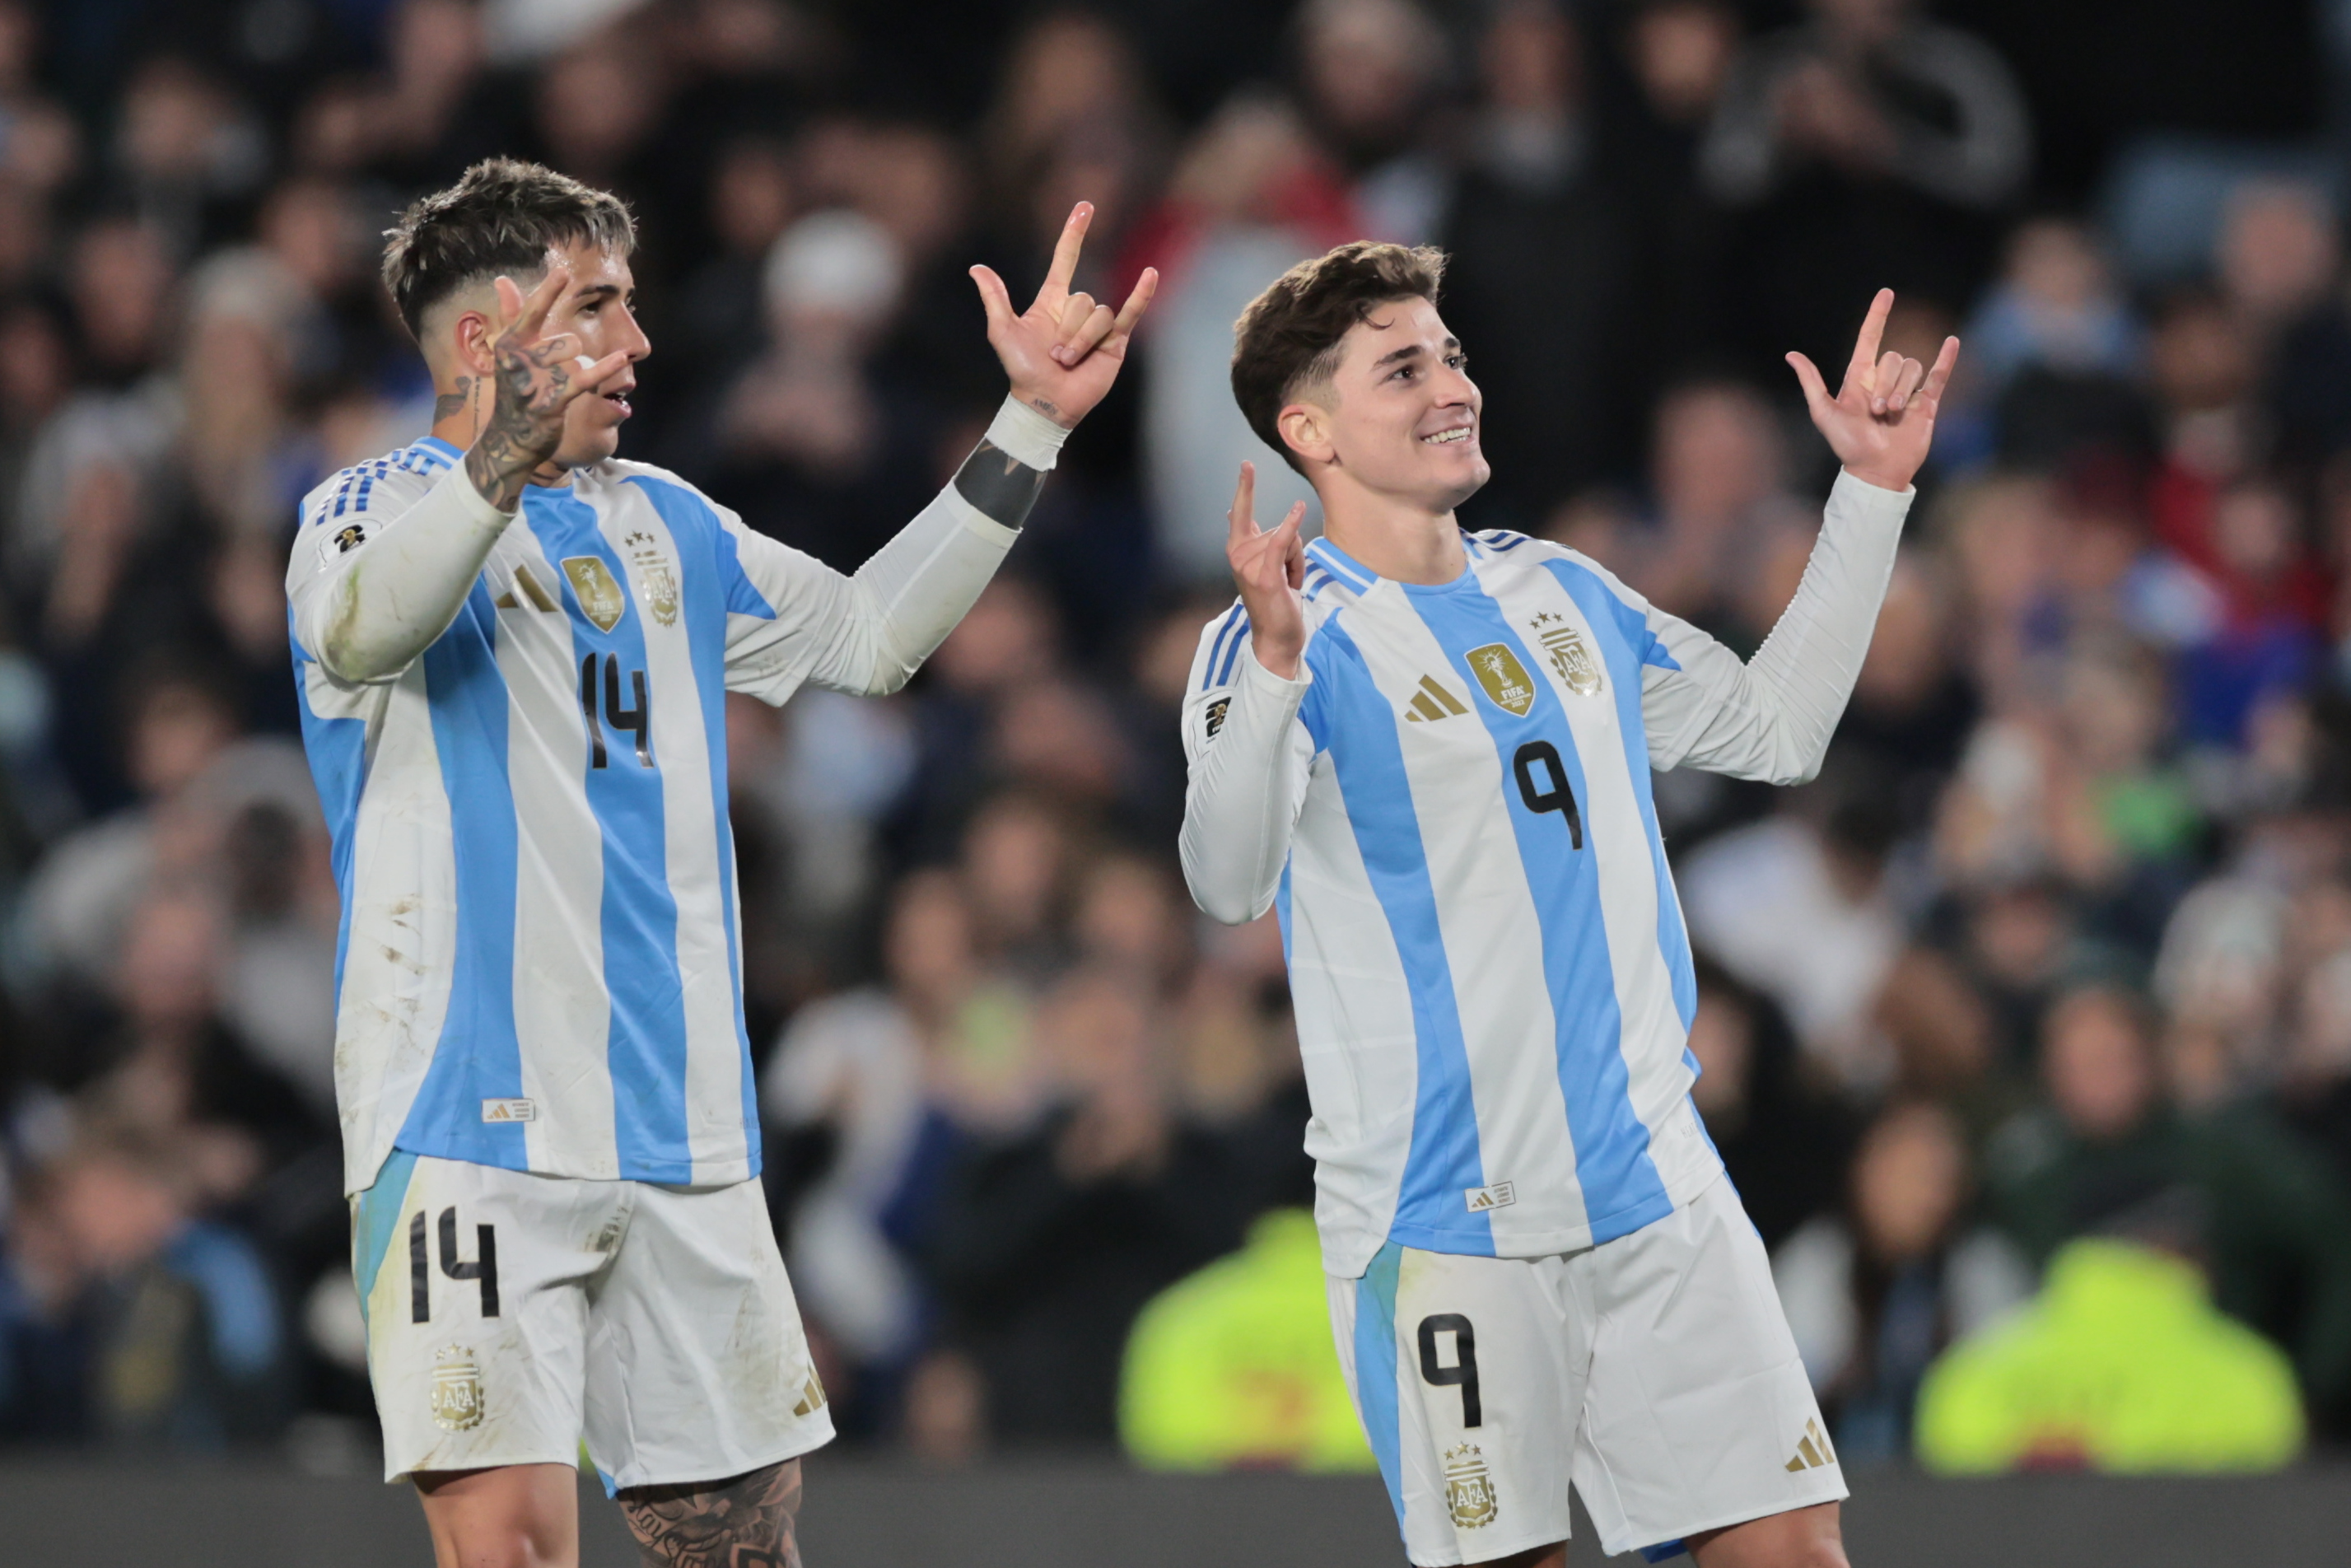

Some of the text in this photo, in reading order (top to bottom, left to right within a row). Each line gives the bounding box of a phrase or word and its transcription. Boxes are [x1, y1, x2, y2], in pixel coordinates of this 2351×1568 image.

[1500, 686, 1525, 700] FIFA
[1557, 645, 1591, 675] AFA
[581, 651, 655, 769] 14
[1514, 740, 1584, 851] 9
[409, 1206, 500, 1323] 14
[443, 1382, 476, 1412] AFA
[1417, 1313, 1482, 1429] 9
[1456, 1479, 1488, 1510] AFA
